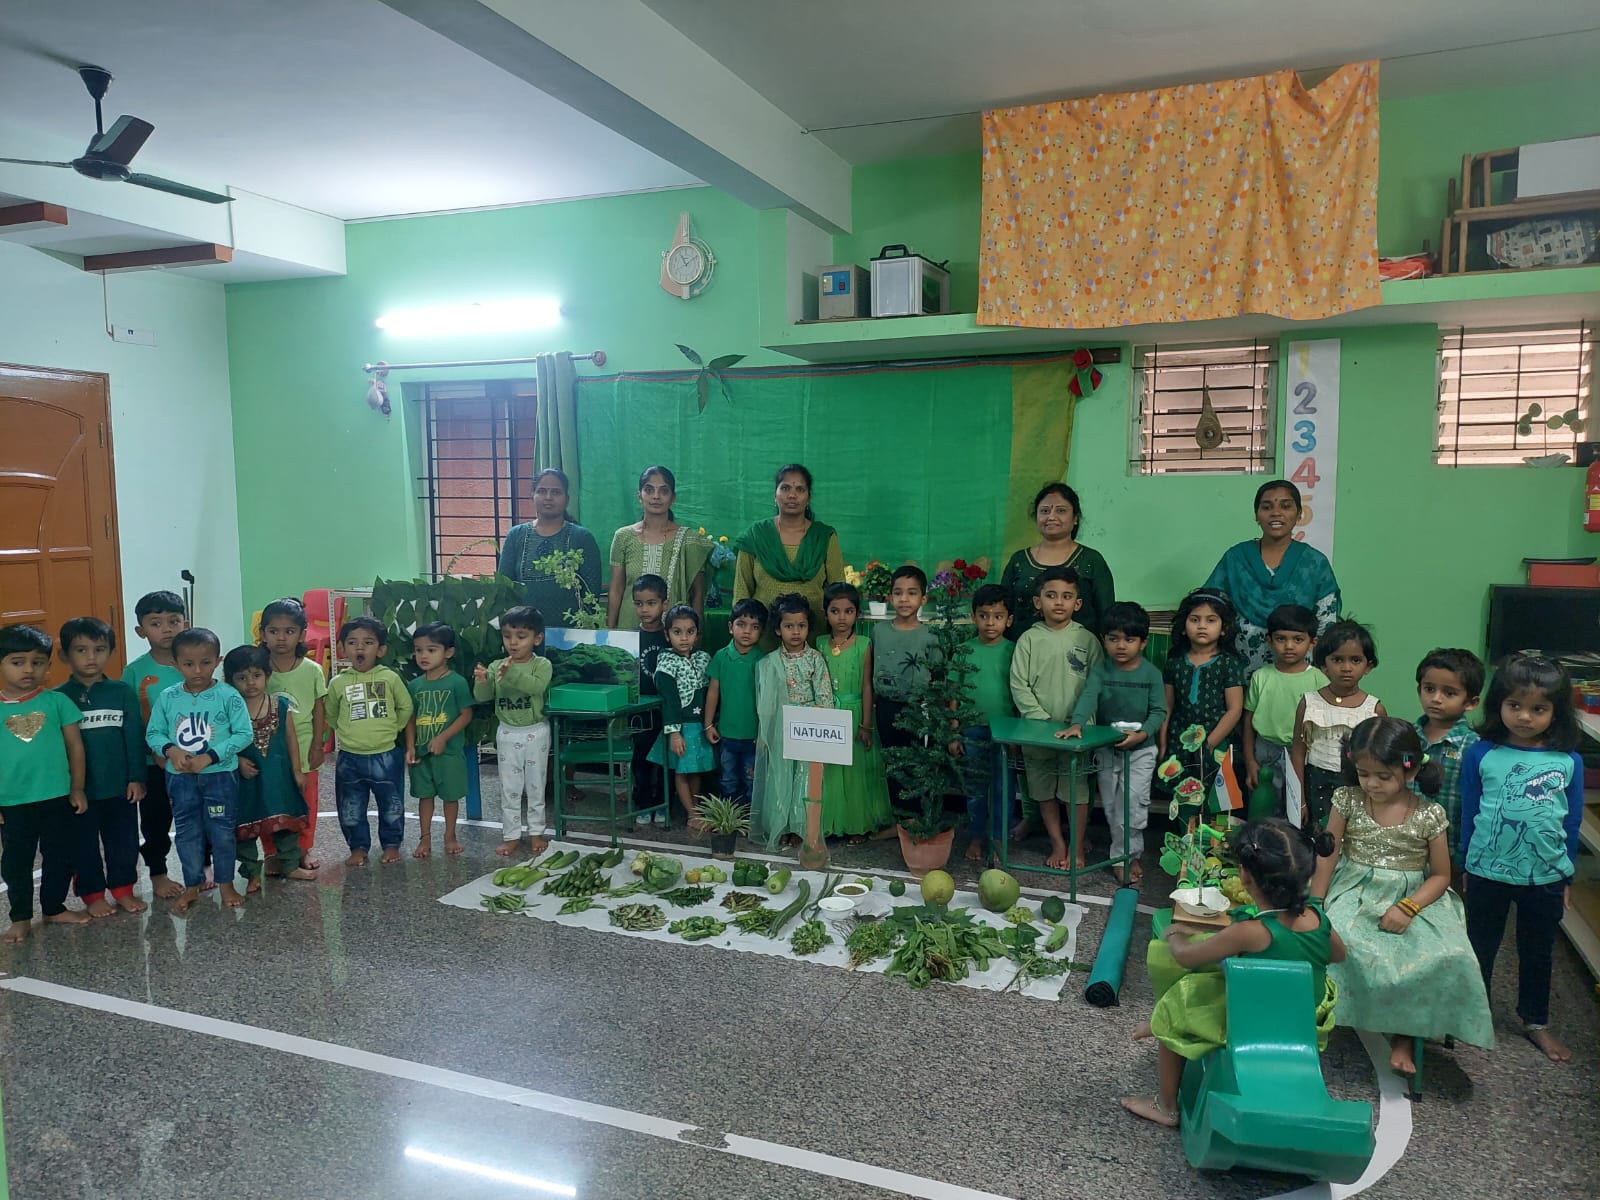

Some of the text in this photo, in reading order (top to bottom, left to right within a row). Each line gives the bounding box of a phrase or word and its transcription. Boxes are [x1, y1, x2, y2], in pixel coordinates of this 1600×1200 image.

[1296, 344, 1310, 377] 1
[1293, 381, 1317, 415] 2
[1291, 420, 1317, 453] 3
[1290, 456, 1321, 490] 4
[499, 695, 532, 704] PLAY
[80, 714, 125, 724] PERFECT
[793, 726, 844, 740] NATURAL
